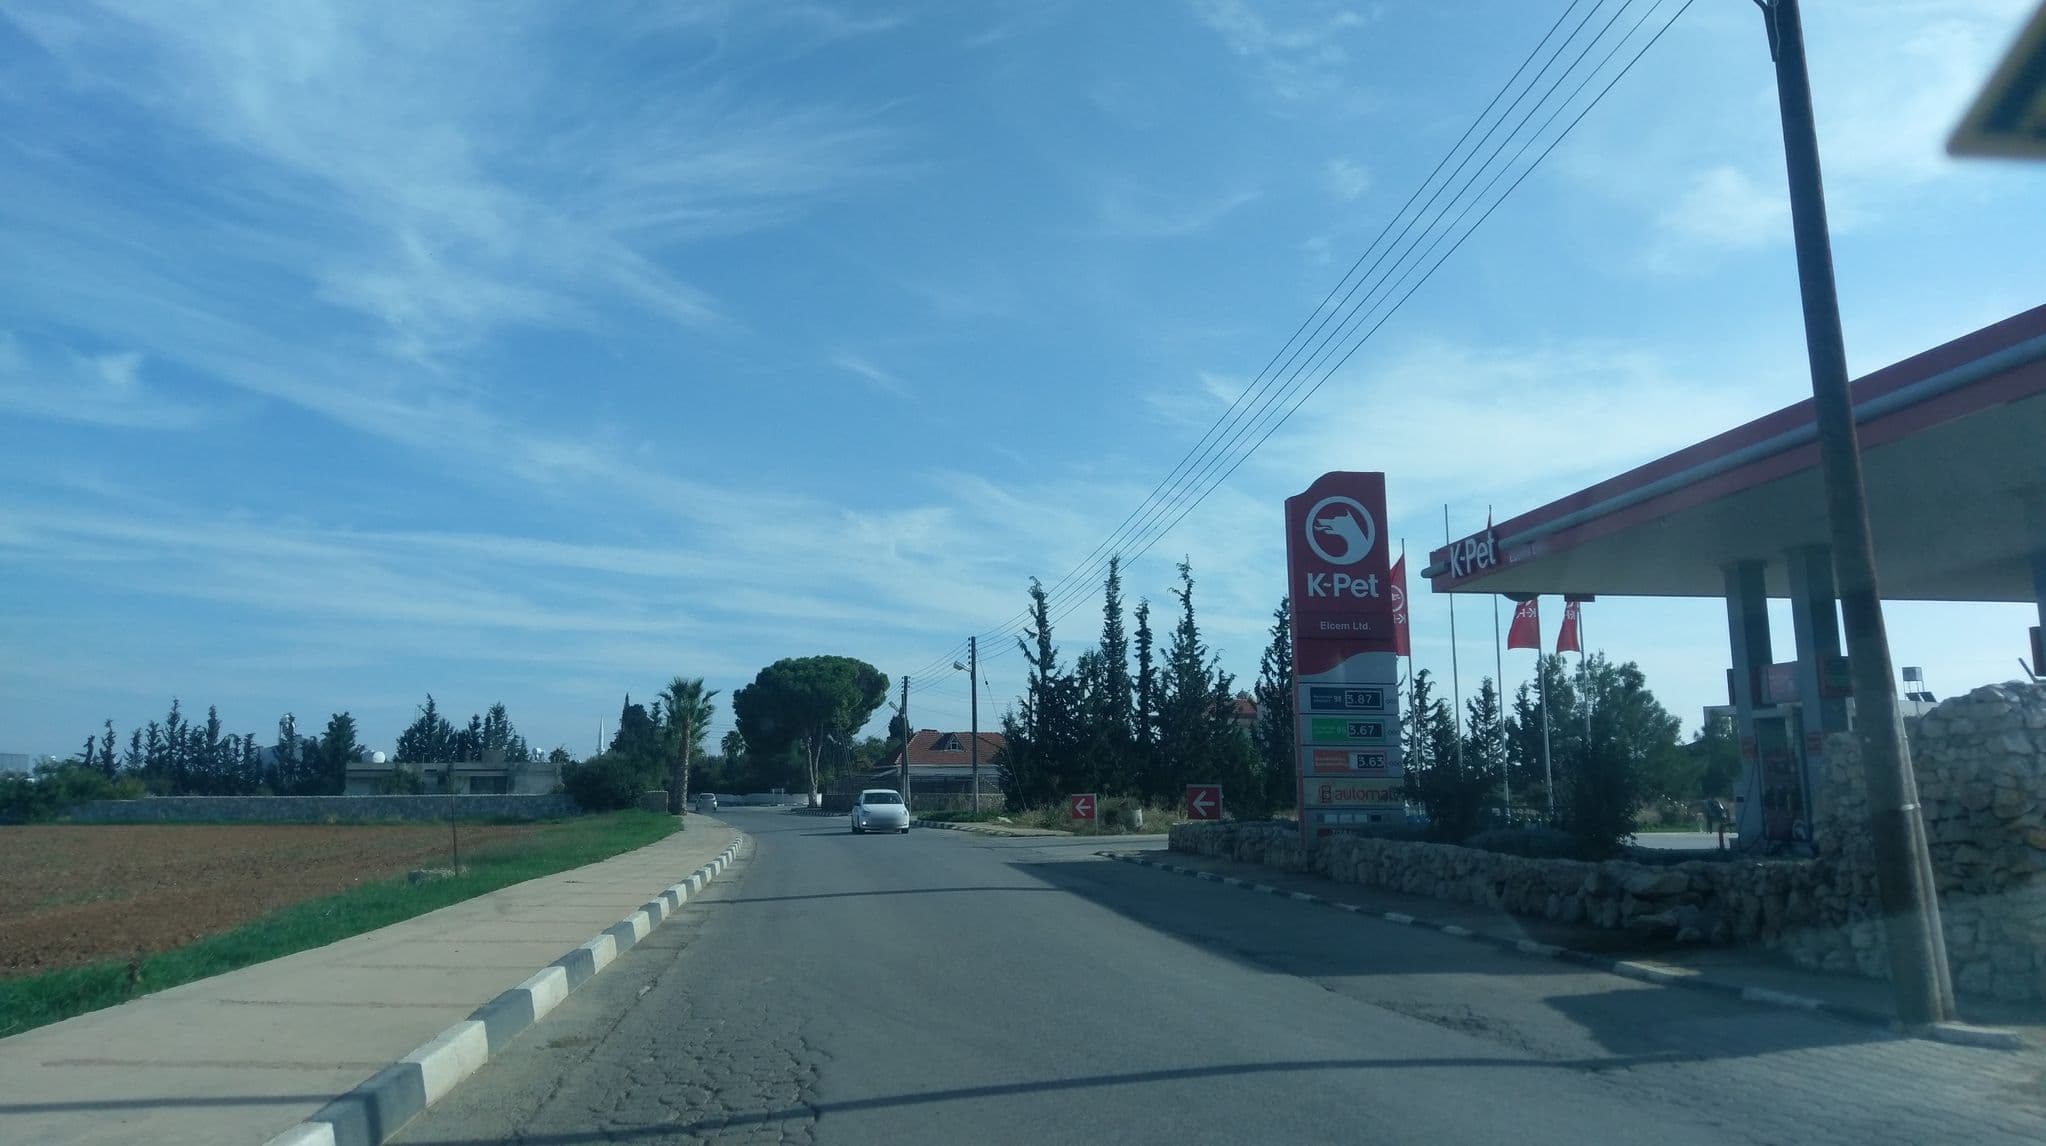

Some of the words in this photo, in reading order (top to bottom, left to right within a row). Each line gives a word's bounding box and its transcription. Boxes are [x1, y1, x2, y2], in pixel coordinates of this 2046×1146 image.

[1450, 531, 1497, 578] K-Pet
[1307, 573, 1379, 597] K-Pet
[1353, 621, 1372, 631] Ltd.
